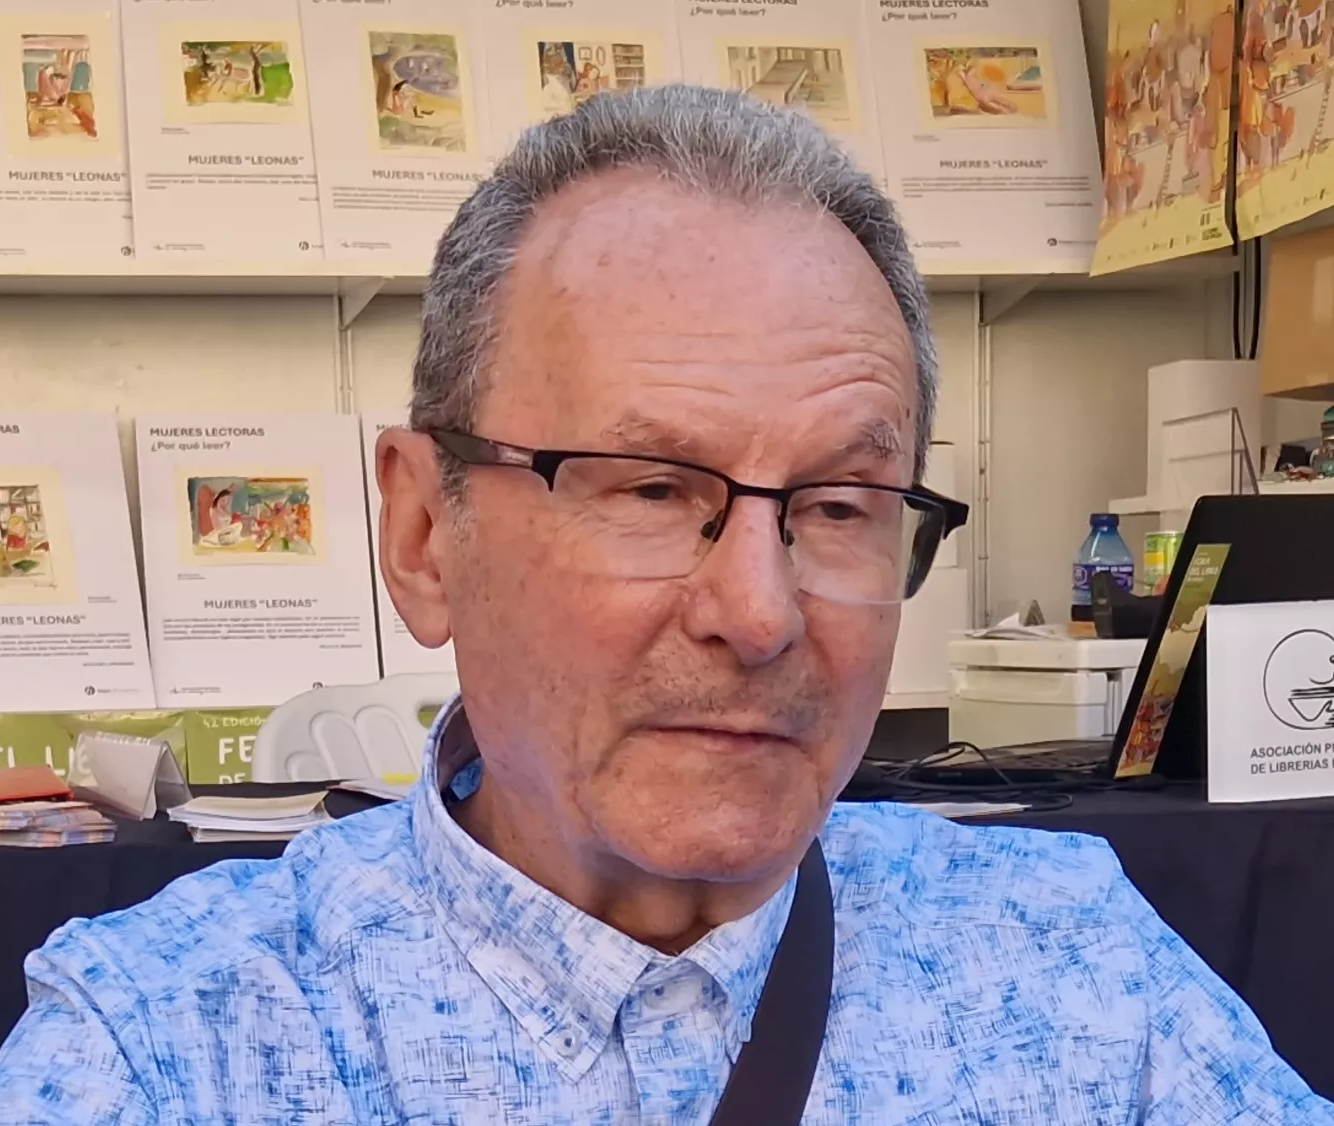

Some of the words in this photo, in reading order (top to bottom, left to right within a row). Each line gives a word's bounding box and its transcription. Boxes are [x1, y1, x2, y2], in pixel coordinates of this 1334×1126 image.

[188, 154, 242, 165] MUJERES
[939, 159, 991, 169] MUJERES
[8, 170, 64, 181] MUJERES
[372, 169, 424, 181] MUJERES
[150, 427, 203, 437] MUJERES
[205, 427, 265, 437] LECTORAS
[204, 600, 257, 609] MUJERES
[223, 715, 266, 727] EDICIÓ
[1250, 742, 1322, 759] ASOCIACIÓN
[1250, 762, 1266, 774] DE
[1269, 758, 1329, 774] LIBRERIAS
